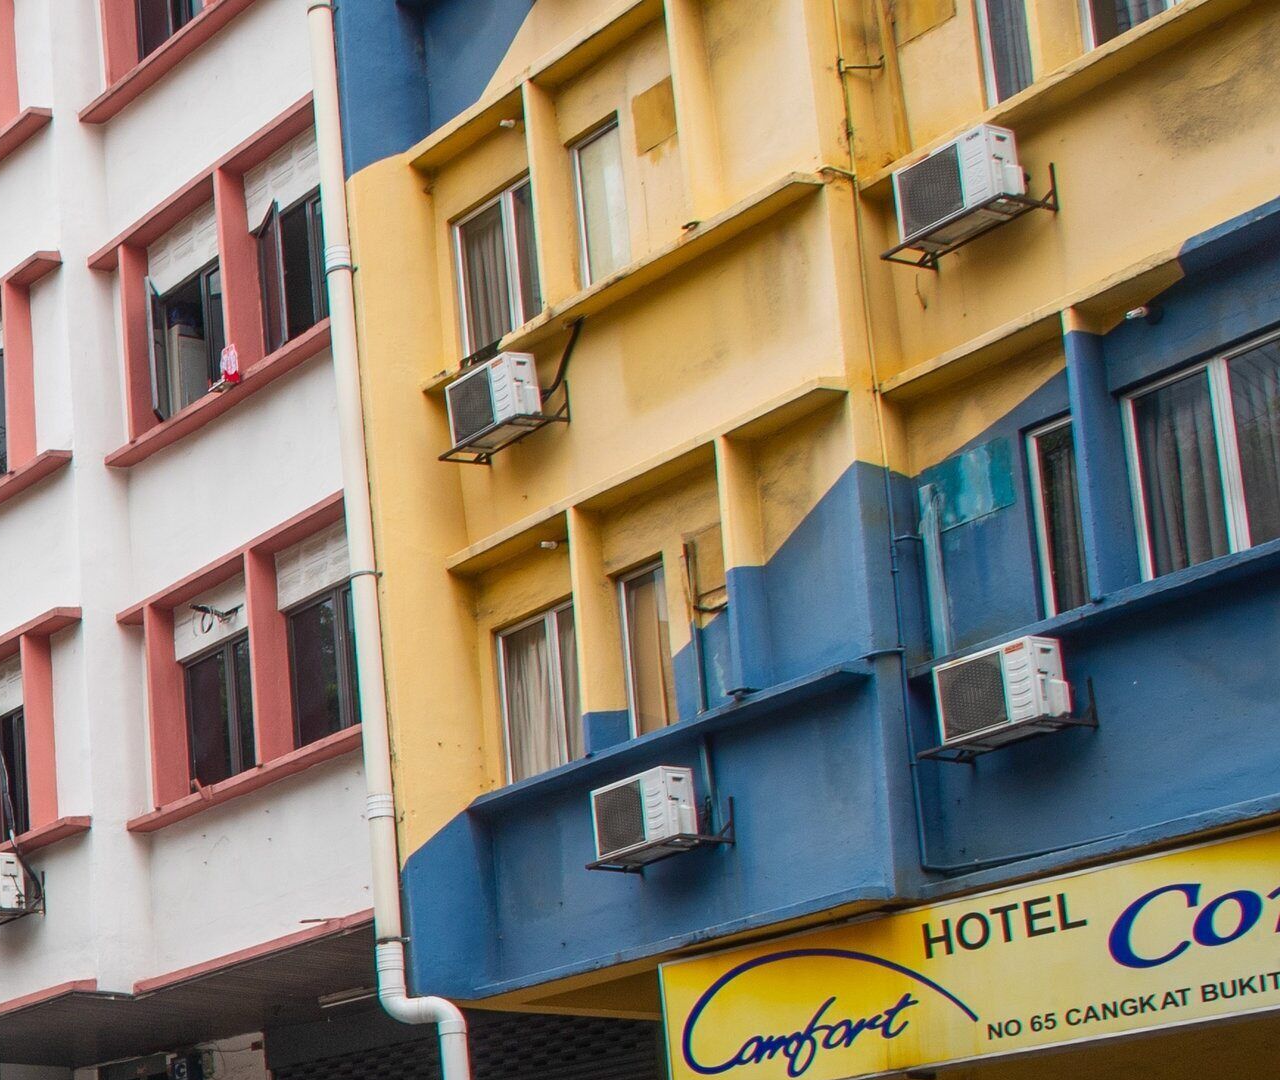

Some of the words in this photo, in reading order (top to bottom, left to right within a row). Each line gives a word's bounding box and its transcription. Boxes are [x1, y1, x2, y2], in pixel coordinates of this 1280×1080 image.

[921, 892, 1088, 960] HOTEL
[1107, 882, 1280, 969] Co
[682, 948, 979, 1078] Comfort
[986, 1018, 1023, 1040] NO
[1030, 1012, 1058, 1034] 65
[1065, 987, 1192, 1027] CANGKAT
